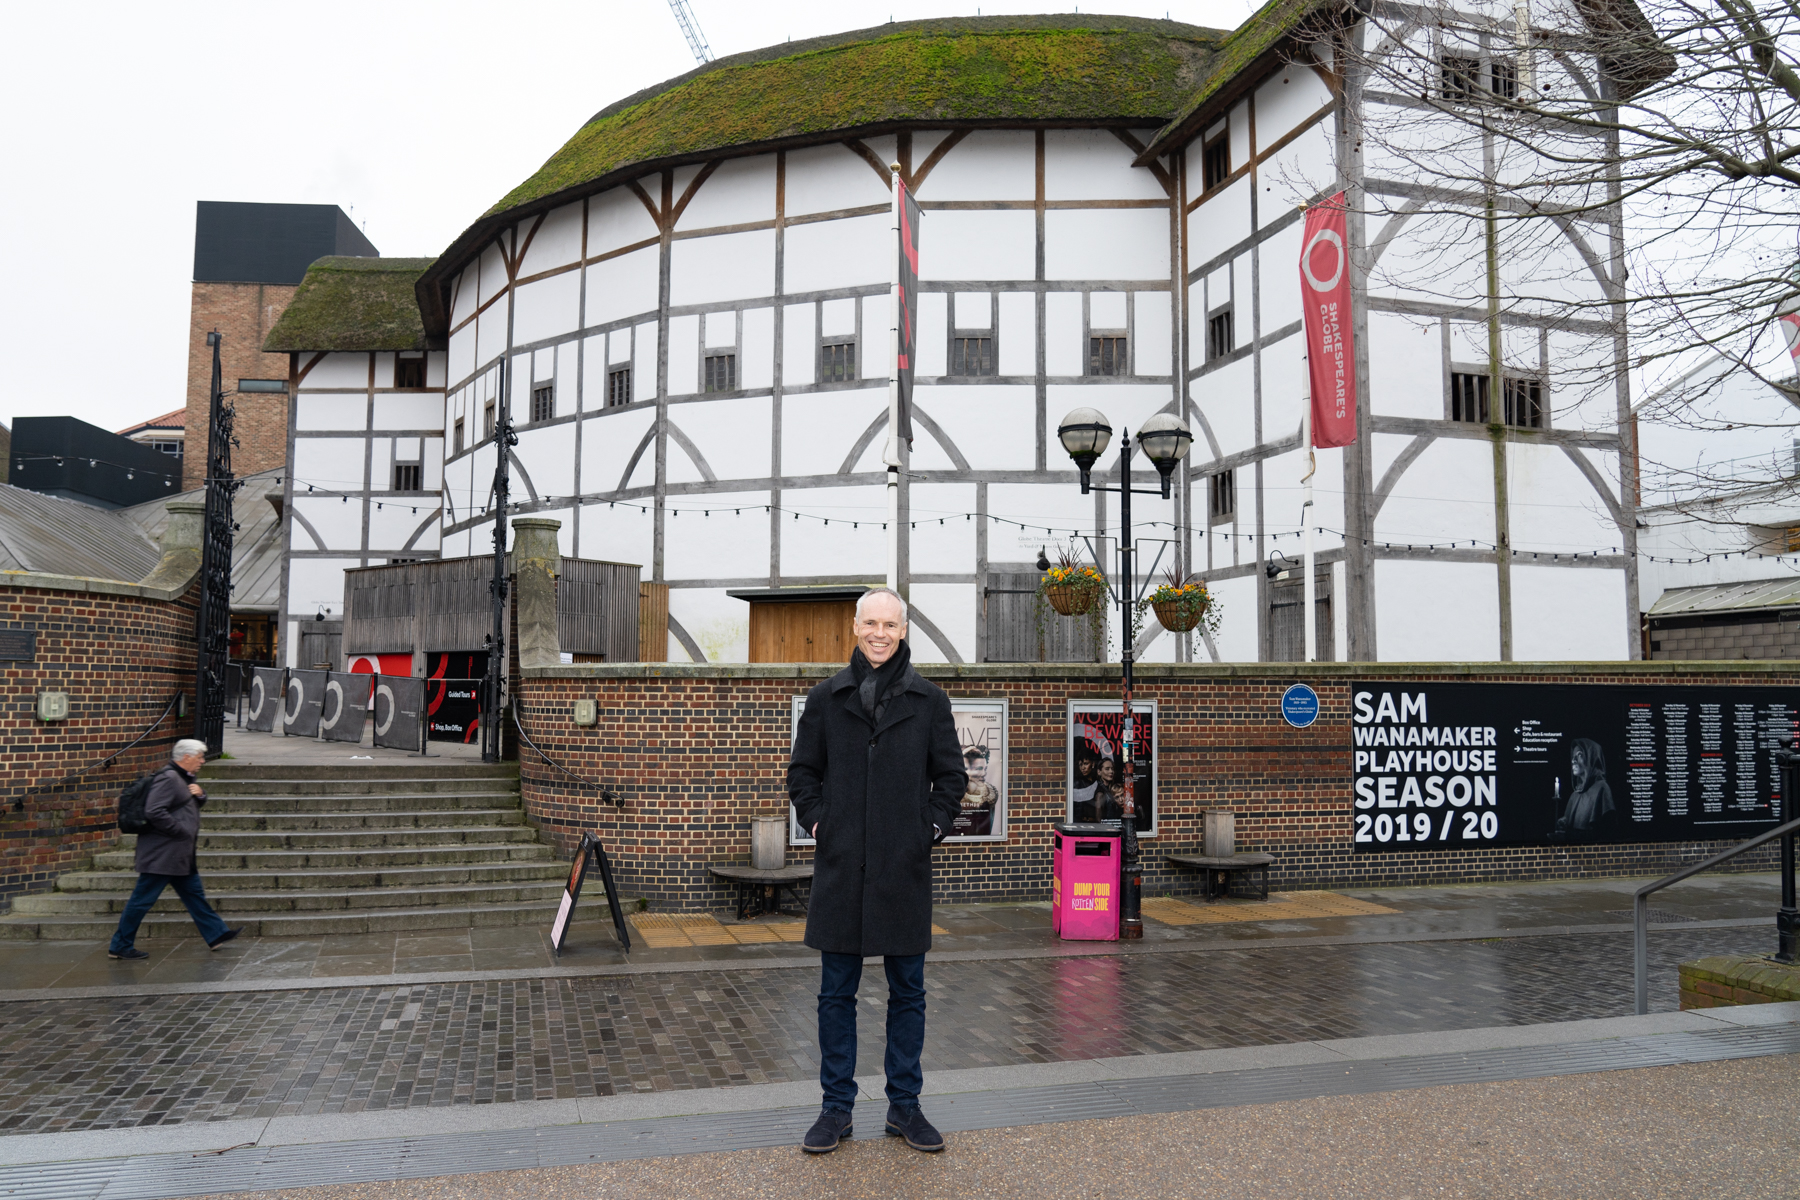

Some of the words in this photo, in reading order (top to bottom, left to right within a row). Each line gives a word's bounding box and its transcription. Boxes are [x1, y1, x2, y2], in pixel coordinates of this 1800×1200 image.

[1320, 304, 1333, 354] GLOBE
[1329, 302, 1346, 419] SHAKESPEARE'S
[448, 690, 460, 698] Guided
[460, 690, 471, 698] Tours
[1353, 691, 1427, 724] SAM
[957, 727, 1000, 751] IVE
[1084, 724, 1152, 739] BEWRE
[1353, 726, 1497, 747] WANAMAKER
[1355, 750, 1497, 773] PLAYHOUSE
[1354, 775, 1497, 809] SEASON
[1355, 812, 1432, 842] 2019
[1439, 810, 1455, 841] /
[1462, 810, 1498, 840] 20
[1074, 882, 1093, 896] DUMP
[1093, 883, 1110, 896] YOUR
[1094, 897, 1109, 911] SIDE
